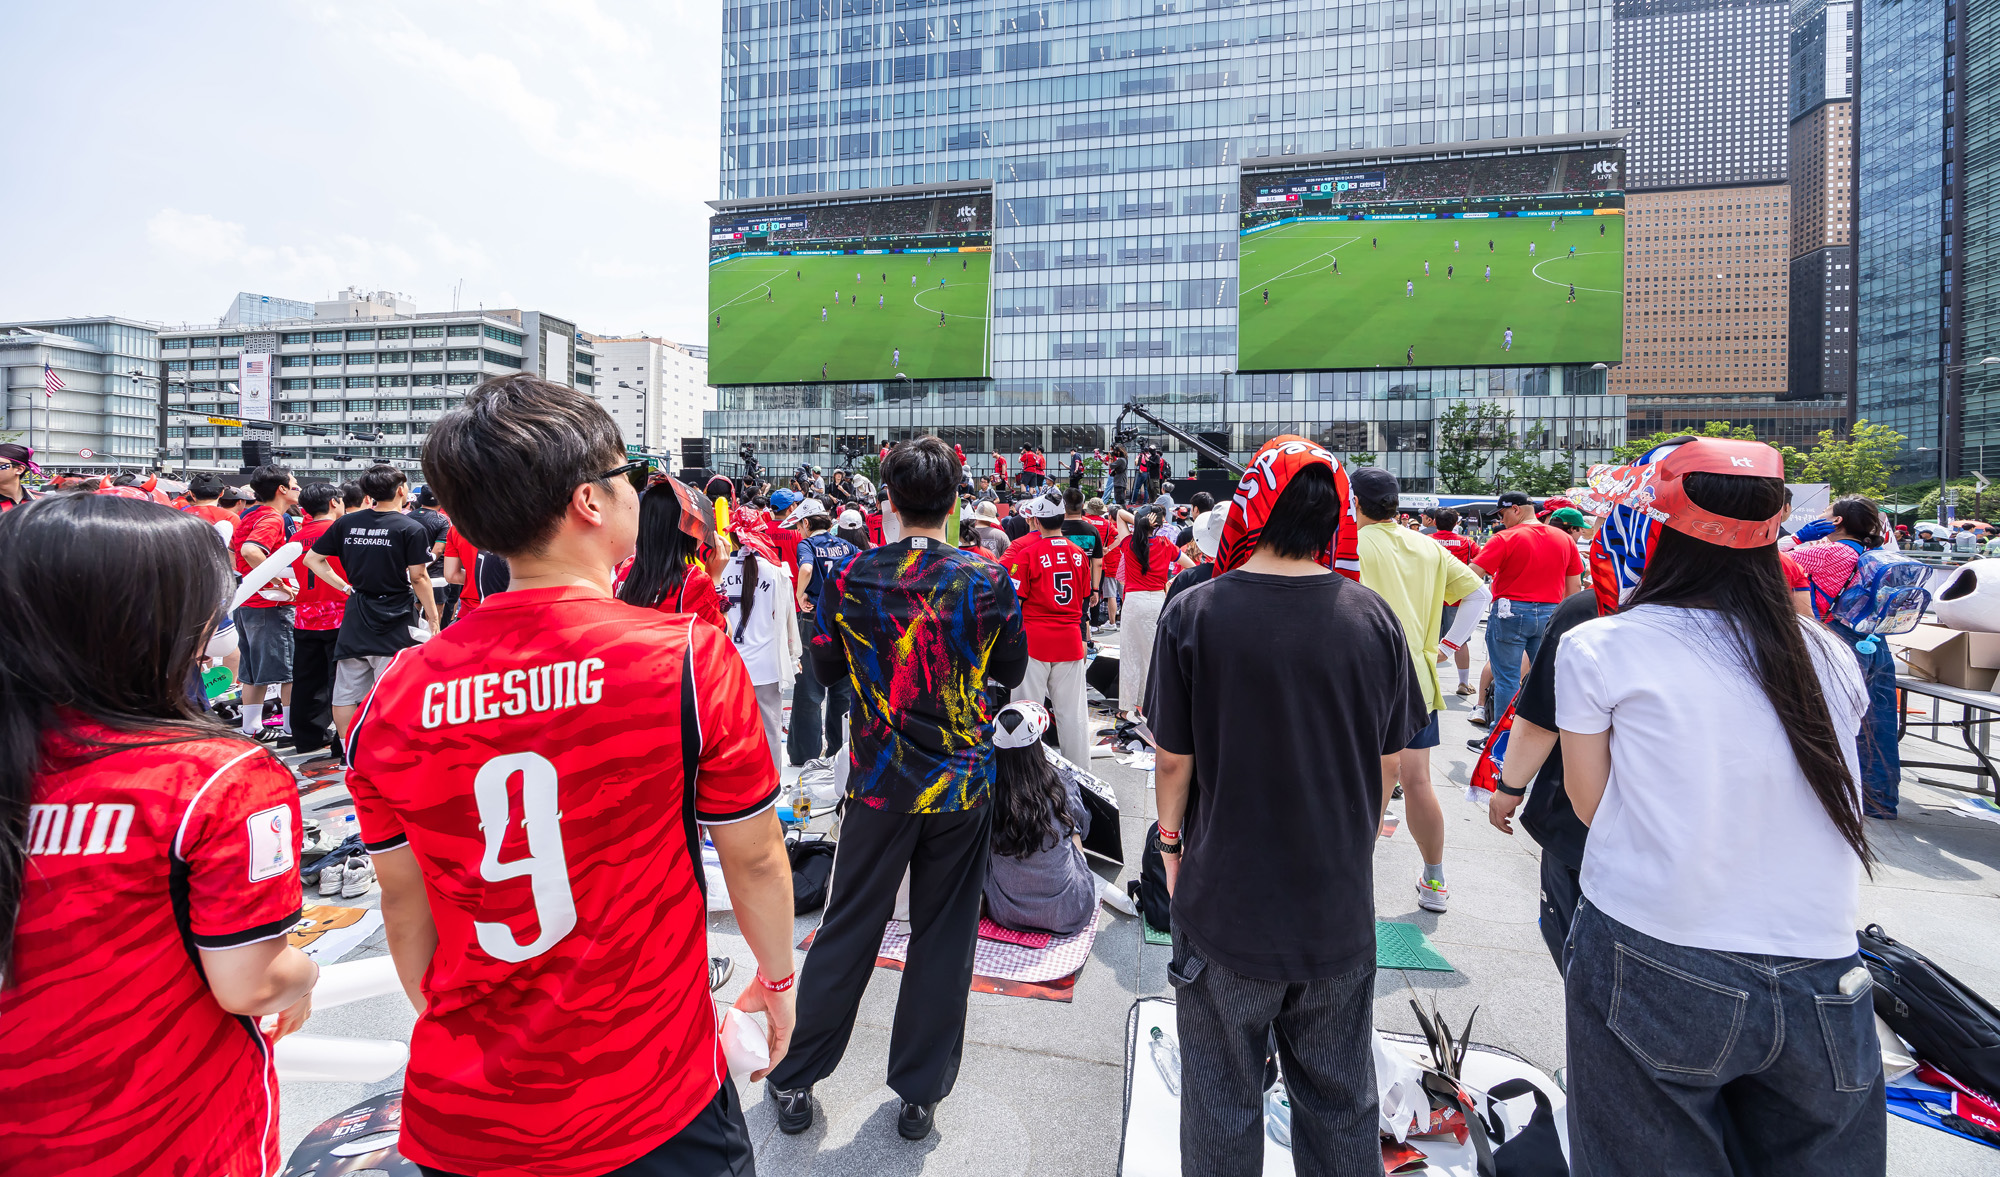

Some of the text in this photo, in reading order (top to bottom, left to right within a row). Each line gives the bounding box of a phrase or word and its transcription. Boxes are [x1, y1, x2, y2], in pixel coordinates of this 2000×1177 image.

[1591, 160, 1618, 174] jtbc
[956, 205, 977, 217] jtbc
[1730, 456, 1754, 467] kt
[344, 537, 392, 547] FC SEORABUL
[815, 547, 827, 558] LEE
[1053, 571, 1073, 606] 5
[421, 656, 604, 729] GUESUNG
[473, 751, 578, 964] 9
[1971, 1113, 1998, 1128] KFA
